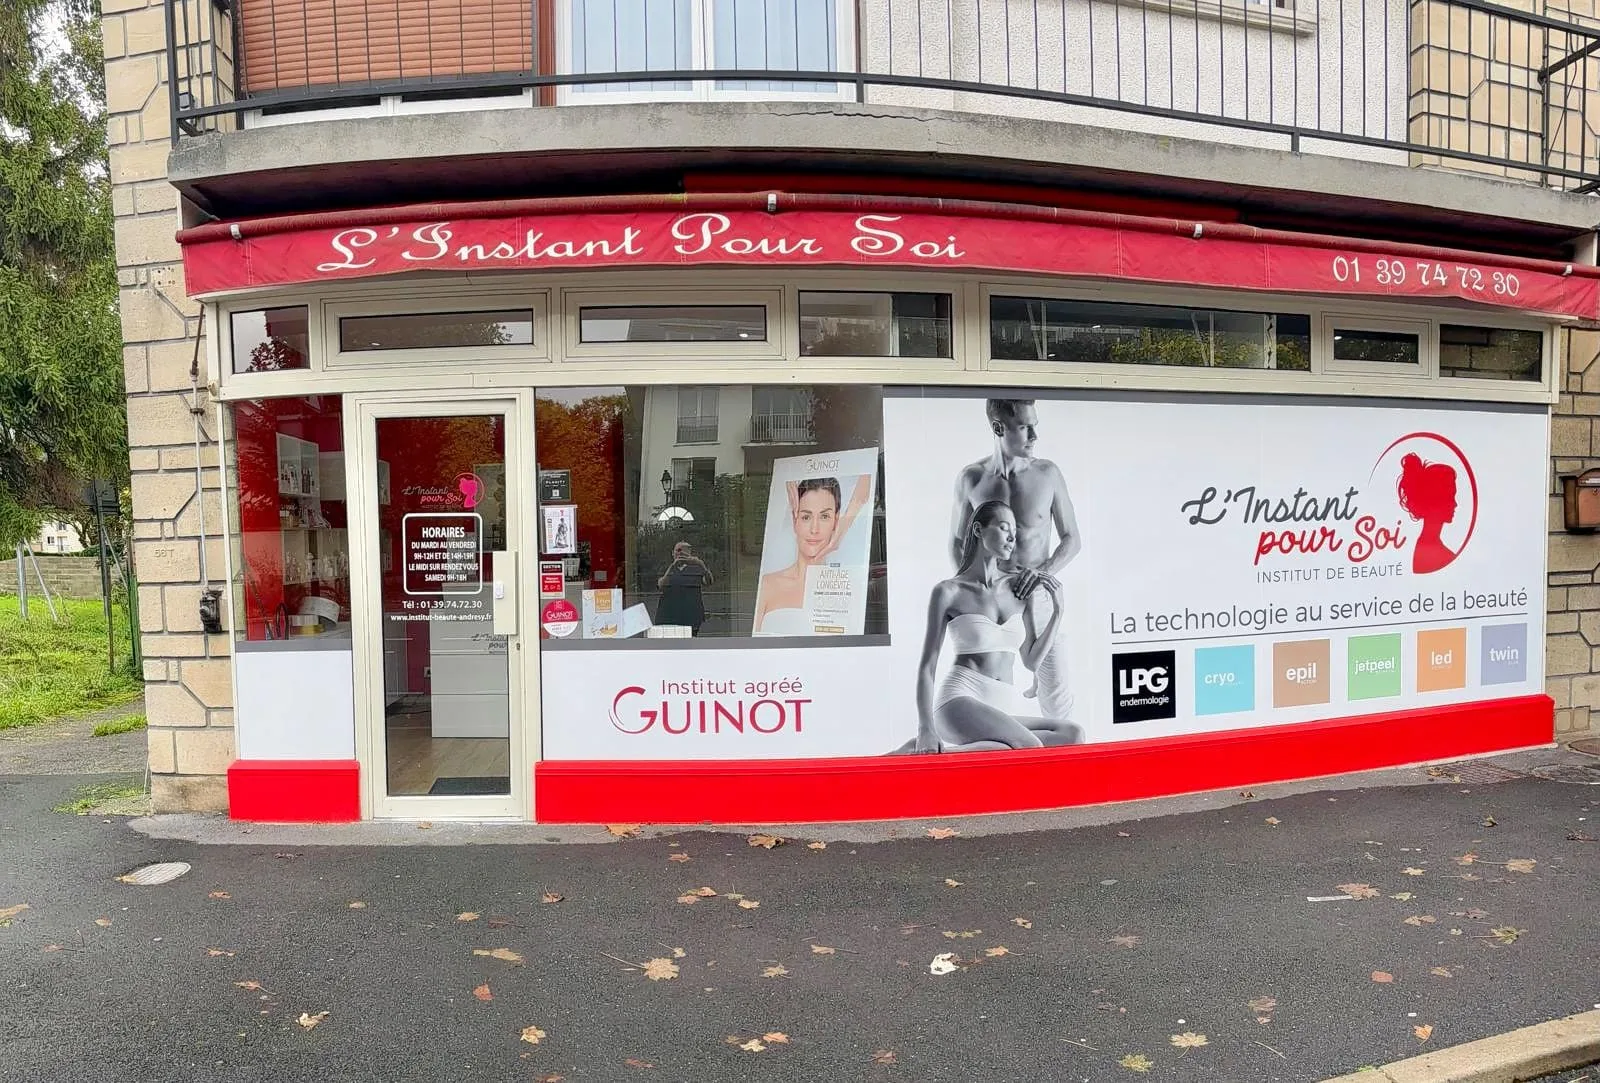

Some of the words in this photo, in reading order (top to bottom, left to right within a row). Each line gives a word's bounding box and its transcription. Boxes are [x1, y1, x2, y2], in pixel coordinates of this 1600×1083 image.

[316, 222, 643, 272] L'Instant
[671, 213, 823, 254] Pour
[851, 215, 965, 258] Soi
[1333, 256, 1360, 282] 01
[1376, 259, 1406, 284] 39
[1417, 262, 1448, 286] 74
[1456, 266, 1485, 291] 72
[1493, 271, 1520, 296] 30
[420, 494, 444, 504] pour
[445, 492, 463, 504] Soi
[1181, 486, 1359, 525] L'Instant
[422, 527, 465, 538] HORAIRES
[1254, 526, 1343, 566] pour
[1348, 515, 1406, 562] Soi
[411, 541, 420, 549] DU
[421, 541, 439, 549] MARDI
[440, 541, 447, 549] AU
[448, 541, 476, 549] VENDREDI
[414, 552, 434, 560] 9H-12H
[442, 552, 450, 560] DE
[409, 563, 415, 571] LE
[416, 563, 428, 571] MIDI
[430, 563, 440, 571] SUR
[441, 563, 462, 571] RENDEZ
[463, 563, 478, 571] VOUS
[1257, 569, 1320, 583] INSTITUT
[1326, 567, 1345, 580] DE
[1351, 562, 1403, 579] BEAUTÉ
[402, 600, 415, 609] Tél
[421, 600, 482, 609] 01.39.74.72.30
[1111, 612, 1136, 634] La
[1145, 603, 1288, 632] technologie
[1295, 605, 1322, 623] au
[1330, 596, 1402, 620] service
[1408, 593, 1434, 613] de
[1441, 592, 1456, 612] la
[1463, 587, 1528, 609] beauté
[391, 613, 492, 622] www.institut-beaute-andresy.fr
[1431, 649, 1453, 666] led
[1489, 645, 1519, 662] twin
[1286, 662, 1317, 683] epil
[1355, 656, 1395, 675] jetpeel
[662, 678, 736, 695] Institut
[745, 677, 802, 697] agréé
[1120, 666, 1169, 695] LPG
[1204, 672, 1235, 686] cryo
[1120, 694, 1170, 707] endermologie
[608, 686, 812, 734] GUINOT
